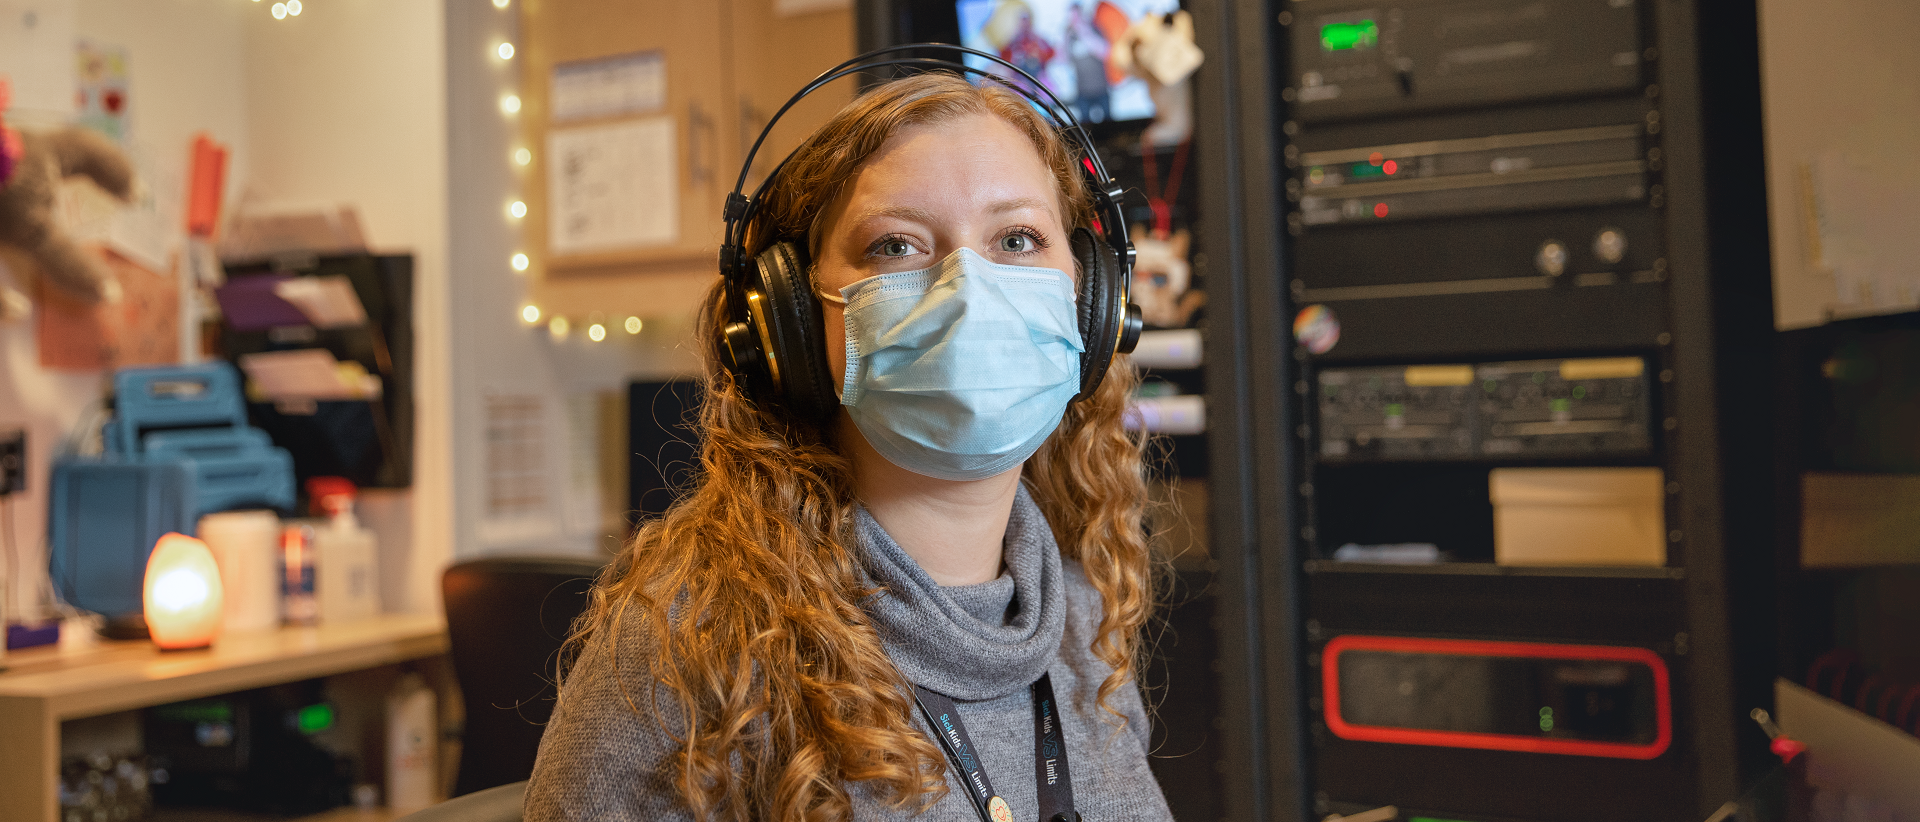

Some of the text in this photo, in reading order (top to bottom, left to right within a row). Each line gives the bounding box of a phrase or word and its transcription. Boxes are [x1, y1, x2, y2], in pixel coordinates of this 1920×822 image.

[1041, 699, 1051, 734] SickKids
[940, 713, 961, 748] SickKids
[971, 771, 988, 798] Limits
[1045, 758, 1058, 785] Limits
